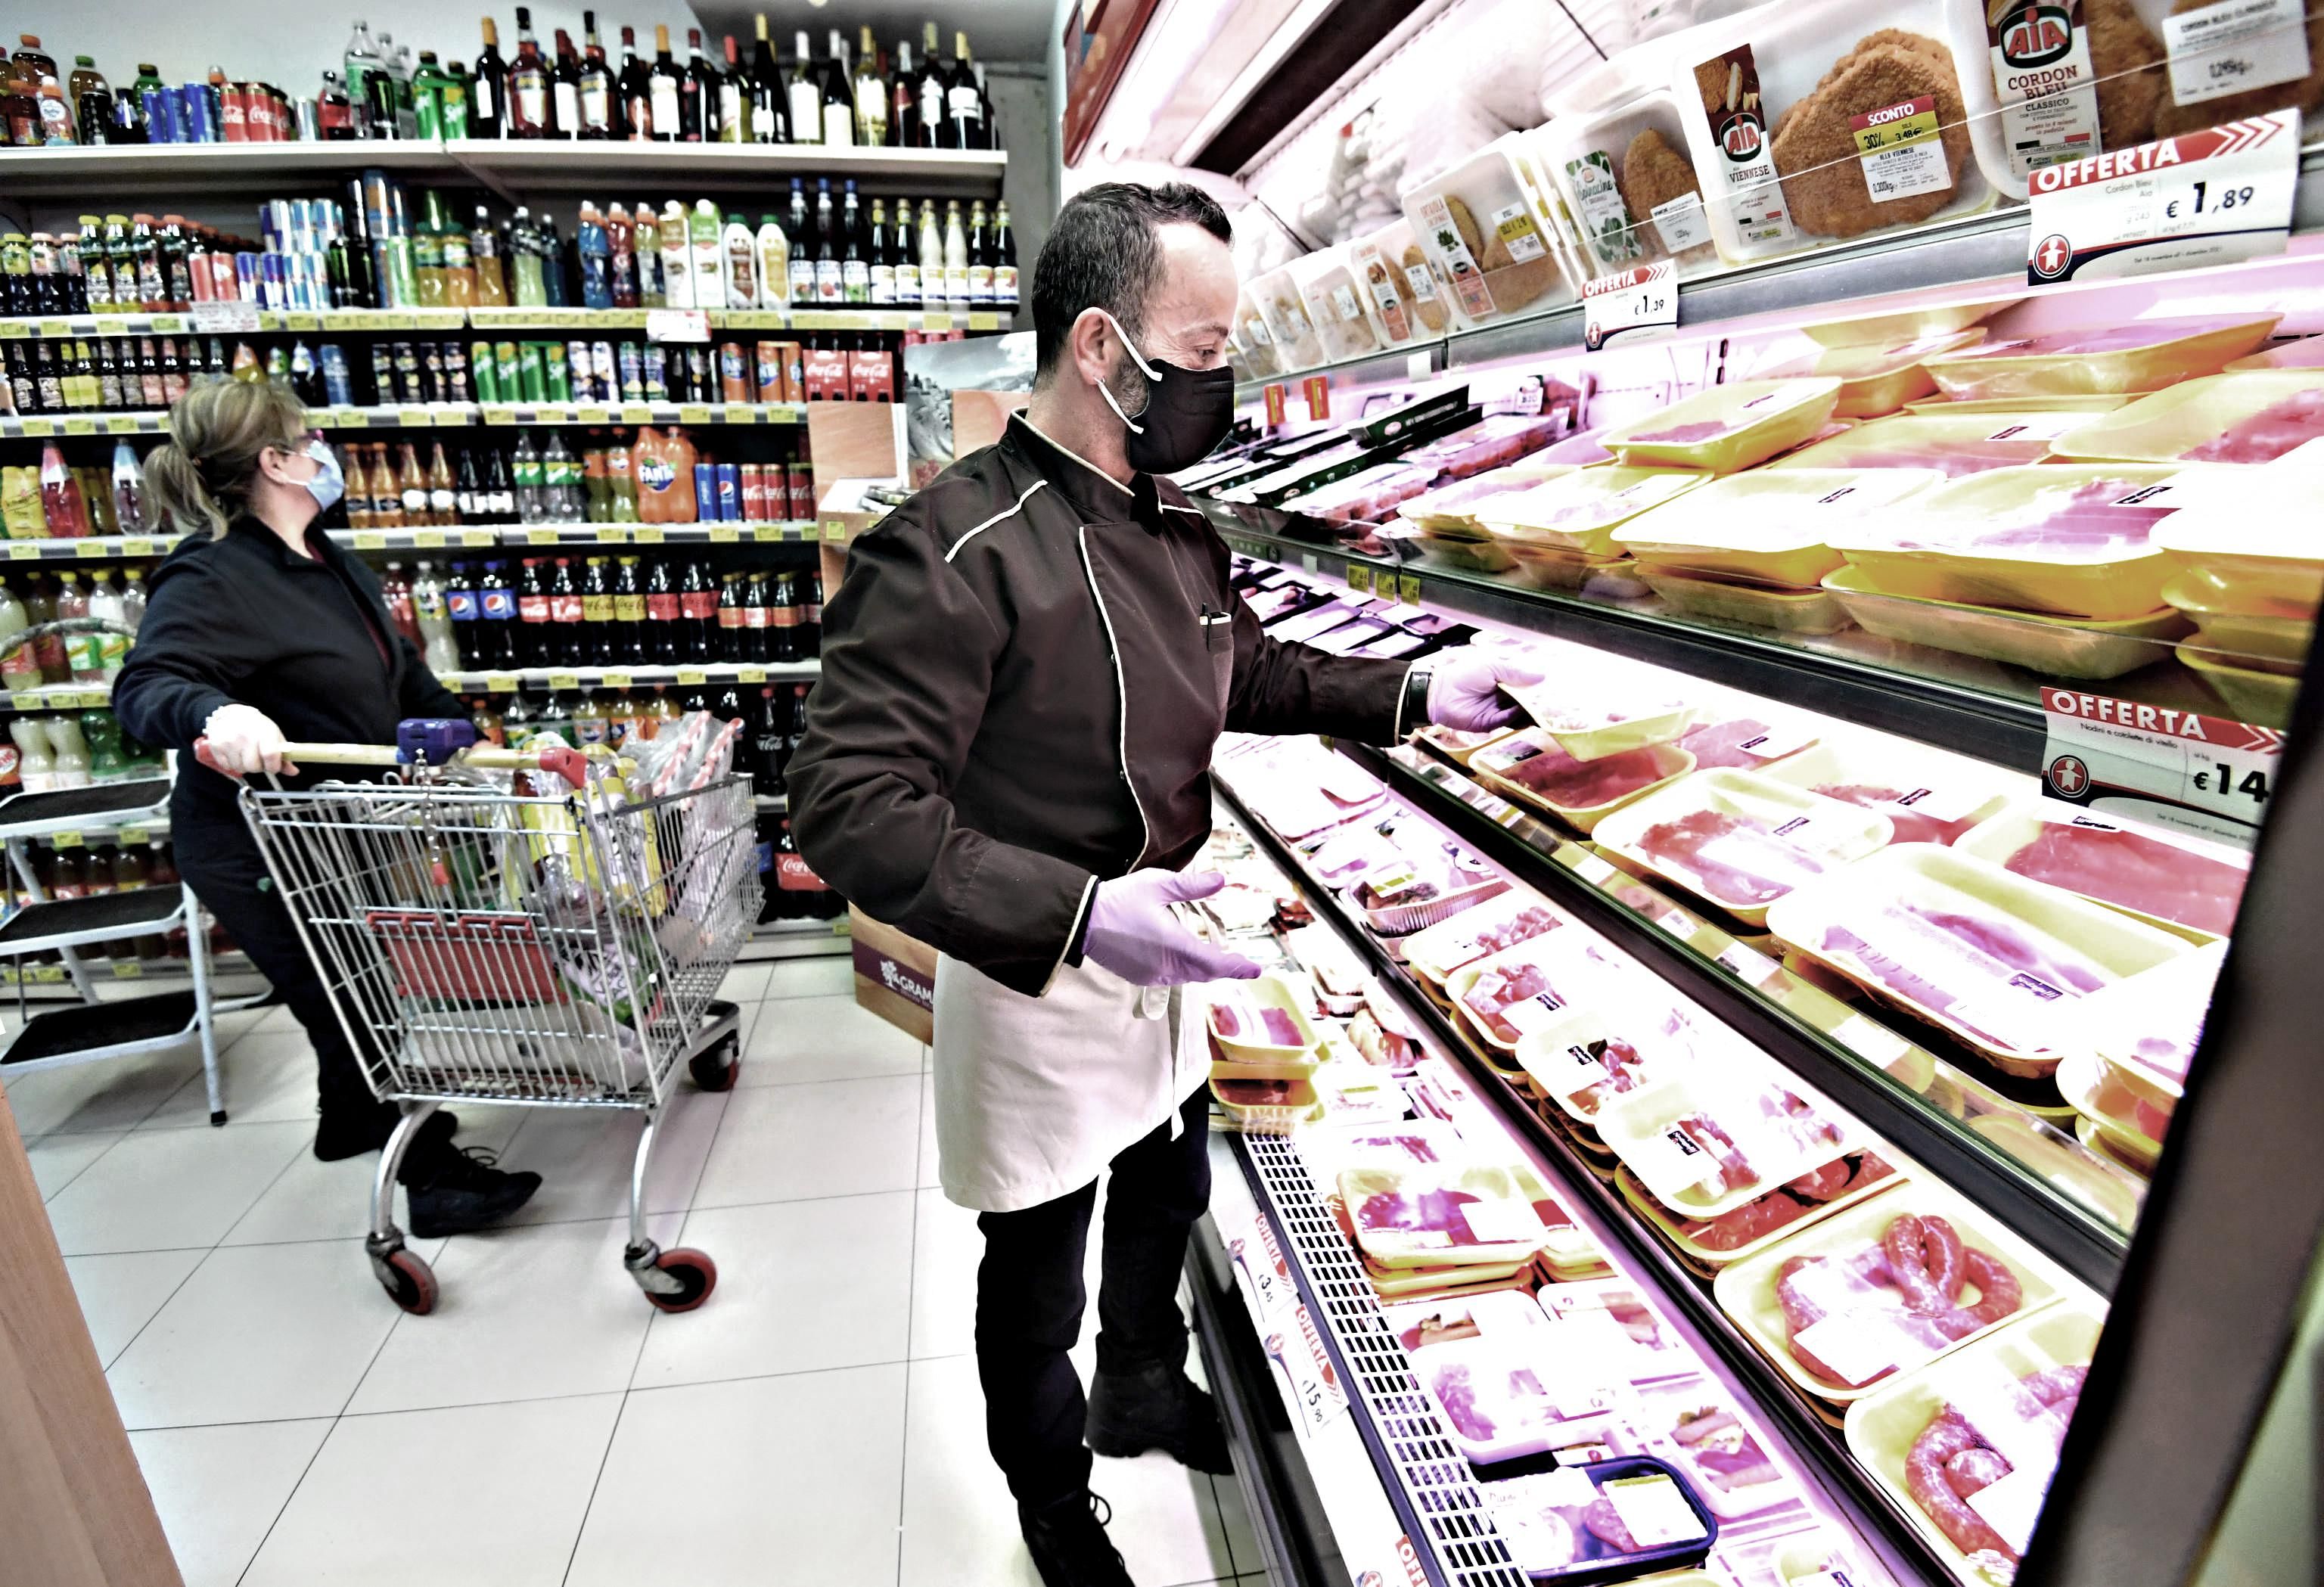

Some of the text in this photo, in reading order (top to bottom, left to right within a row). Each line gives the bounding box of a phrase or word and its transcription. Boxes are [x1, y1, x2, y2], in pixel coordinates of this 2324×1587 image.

[2008, 64, 2078, 91] CORDON
[1867, 103, 1915, 126] SCONTO
[2024, 97, 2070, 112] CLASSICO
[1863, 132, 1885, 150] 30%
[1729, 164, 1770, 184] VIENNESE
[2037, 138, 2181, 191] OFFERTA
[2105, 181, 2133, 195] Cordon
[2166, 181, 2254, 219] € 1,89
[1585, 269, 1637, 297] OFFERTA
[1642, 294, 1664, 314] 1,39
[2050, 691, 2208, 741] OFFERTA
[1257, 1215, 1281, 1268] OFFERTA
[1296, 1306, 1328, 1371] OFFERTA
[1304, 1384, 1323, 1423] 15,90
[1400, 1543, 1430, 1586] OFF
